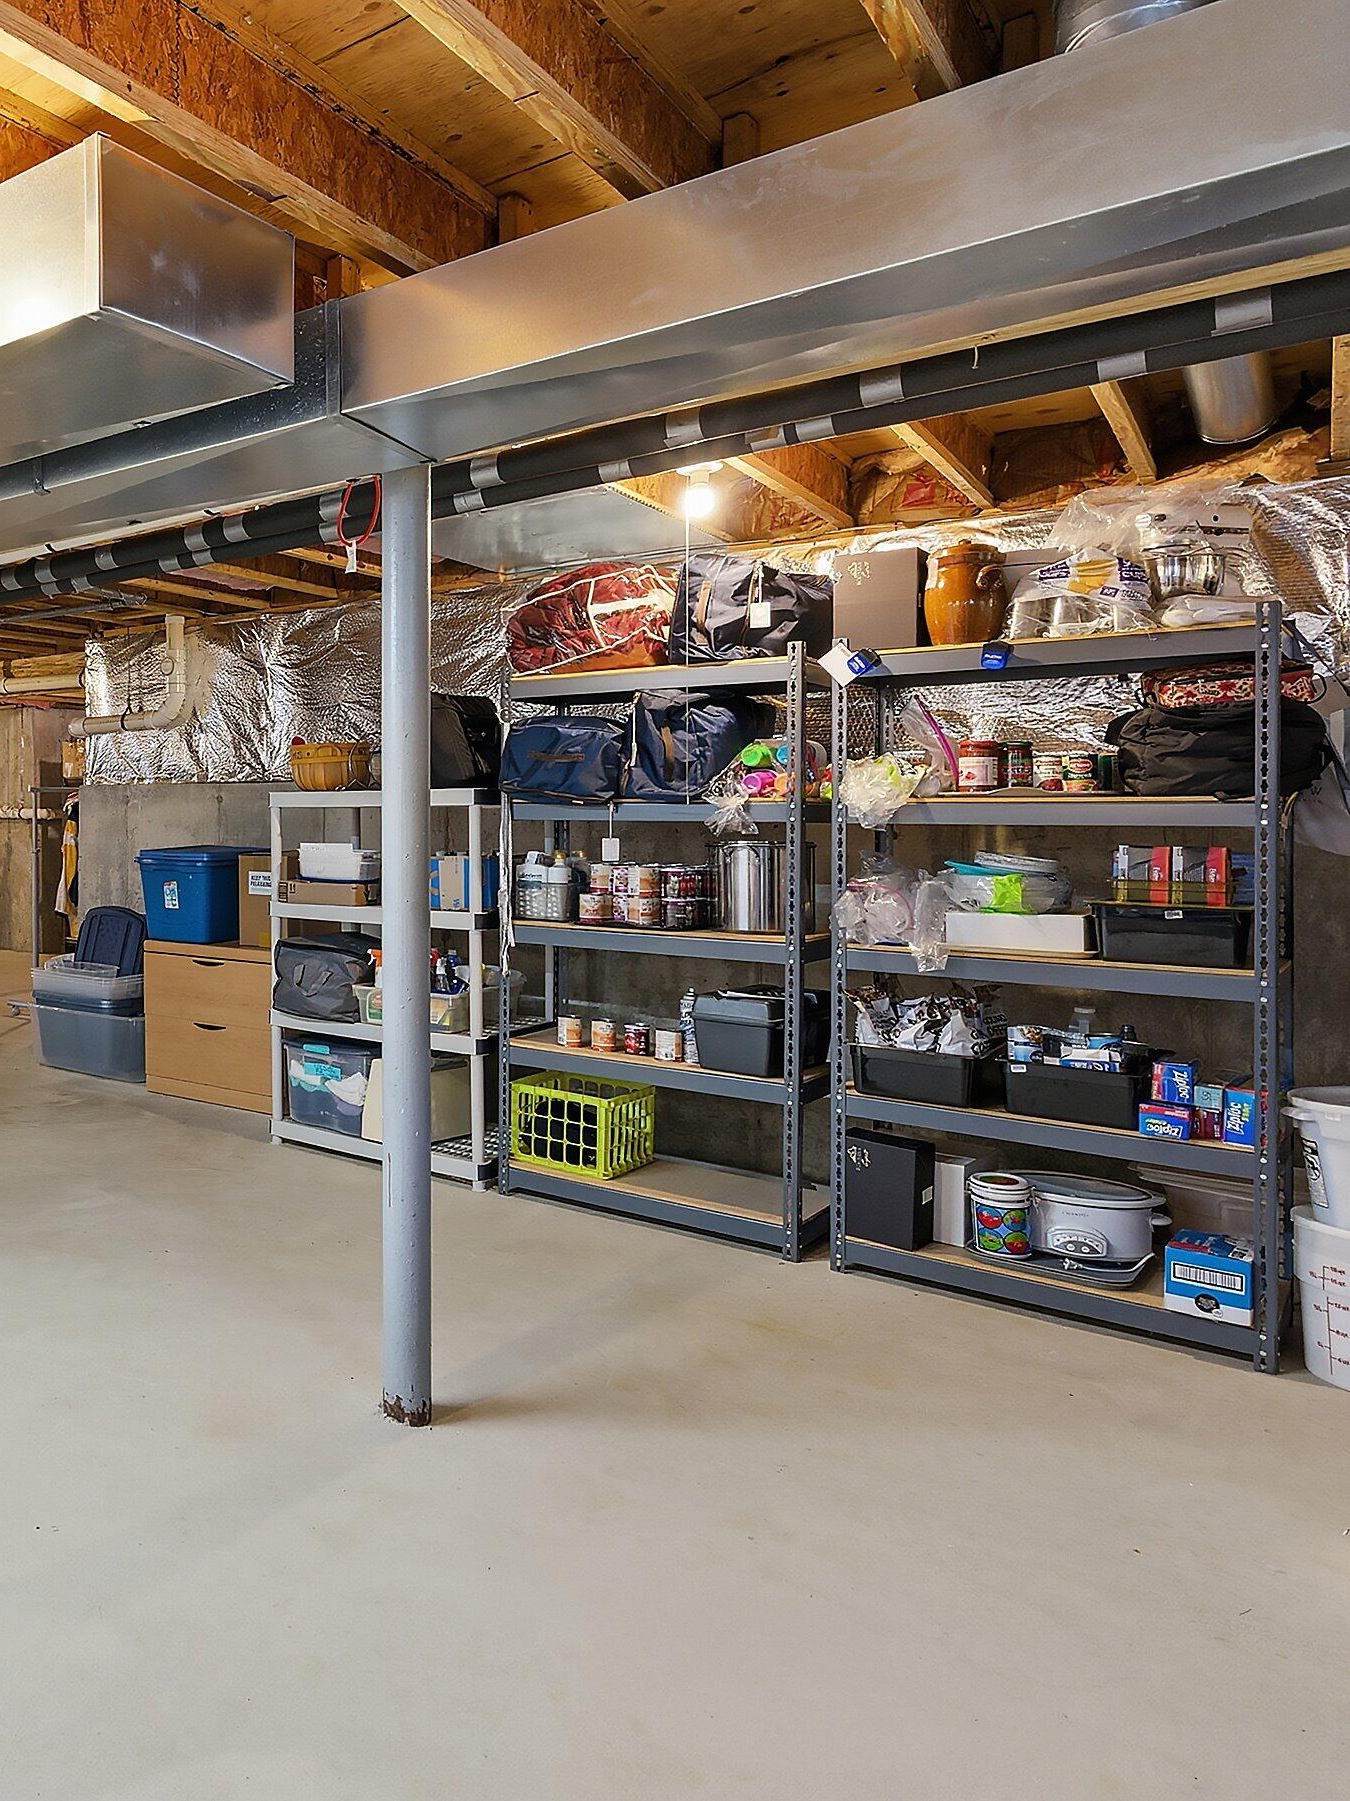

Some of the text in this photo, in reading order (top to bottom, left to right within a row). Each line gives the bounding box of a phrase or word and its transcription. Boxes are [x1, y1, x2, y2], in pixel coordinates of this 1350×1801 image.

[1172, 1070, 1190, 1099] Ziploc
[1146, 1123, 1180, 1136] Ziploc
[1227, 1102, 1244, 1131] Ziploc
